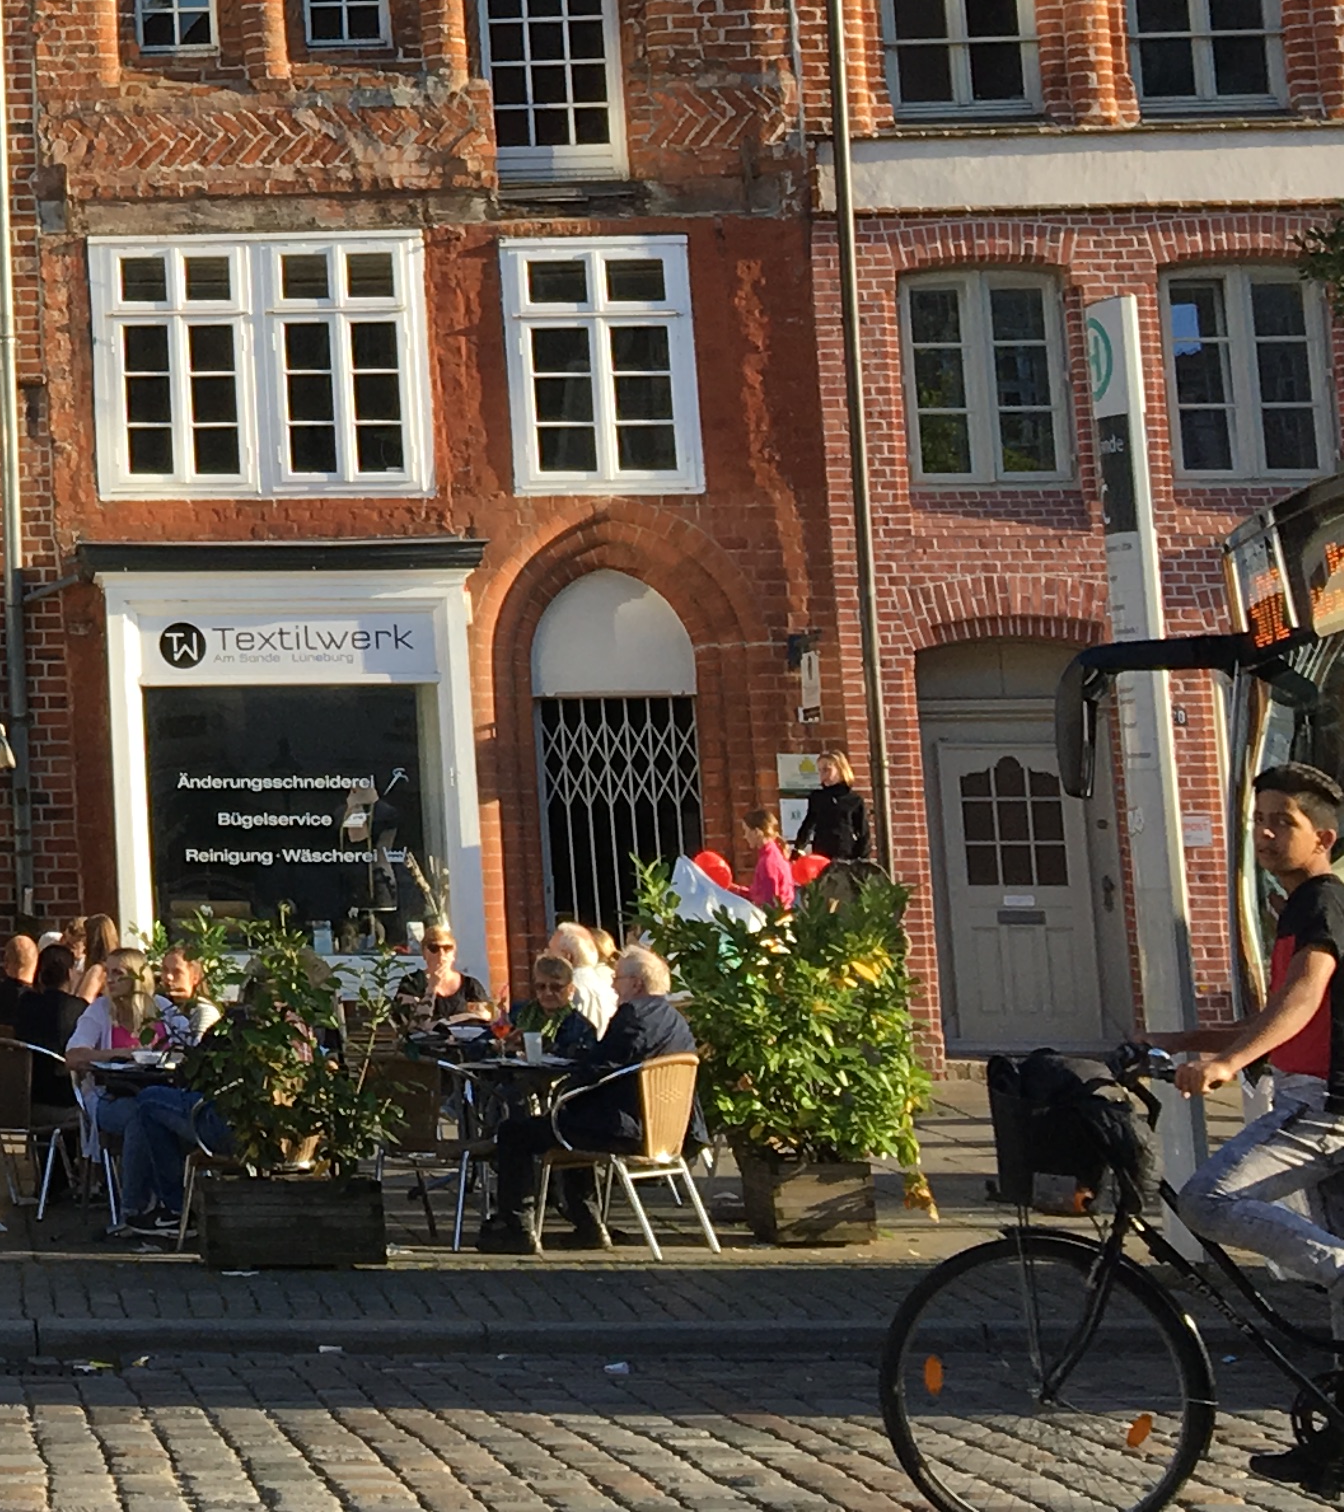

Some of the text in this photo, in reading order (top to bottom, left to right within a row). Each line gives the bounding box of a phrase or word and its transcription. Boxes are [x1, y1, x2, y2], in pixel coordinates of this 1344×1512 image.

[212, 624, 414, 651] Textilwerk
[213, 652, 354, 664] Am Sande Lüneburg
[177, 772, 374, 792] Änderungsschneiderei
[217, 811, 333, 829] Bügelservice
[185, 848, 378, 866] Reinigung Wäscherei
